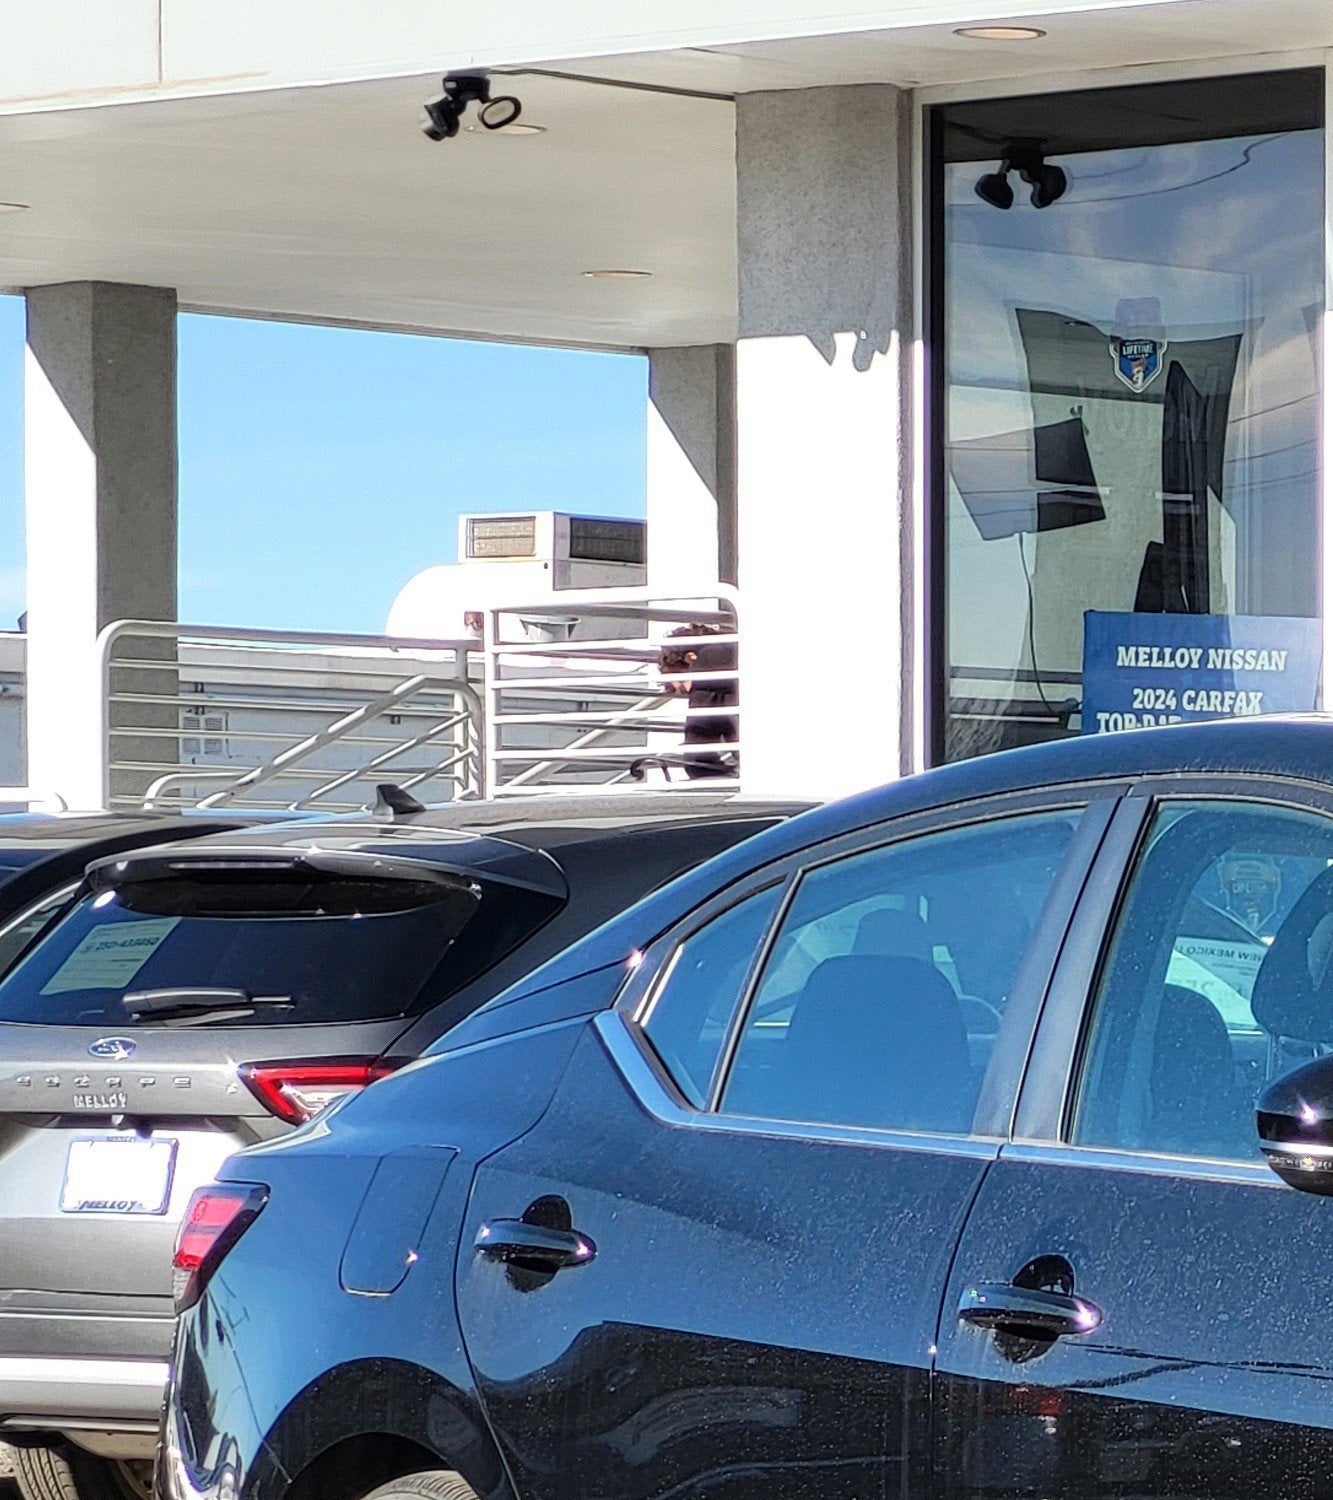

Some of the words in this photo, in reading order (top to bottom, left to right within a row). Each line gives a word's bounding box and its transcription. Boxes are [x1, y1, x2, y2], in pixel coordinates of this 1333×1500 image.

[1116, 645, 1202, 669] MELLOY
[1206, 648, 1287, 671] NISSAN
[1132, 688, 1177, 710] 2024
[1182, 689, 1263, 715] CARFAX
[73, 1092, 127, 1109] MELLOY
[79, 1200, 138, 1211] MELLOY
